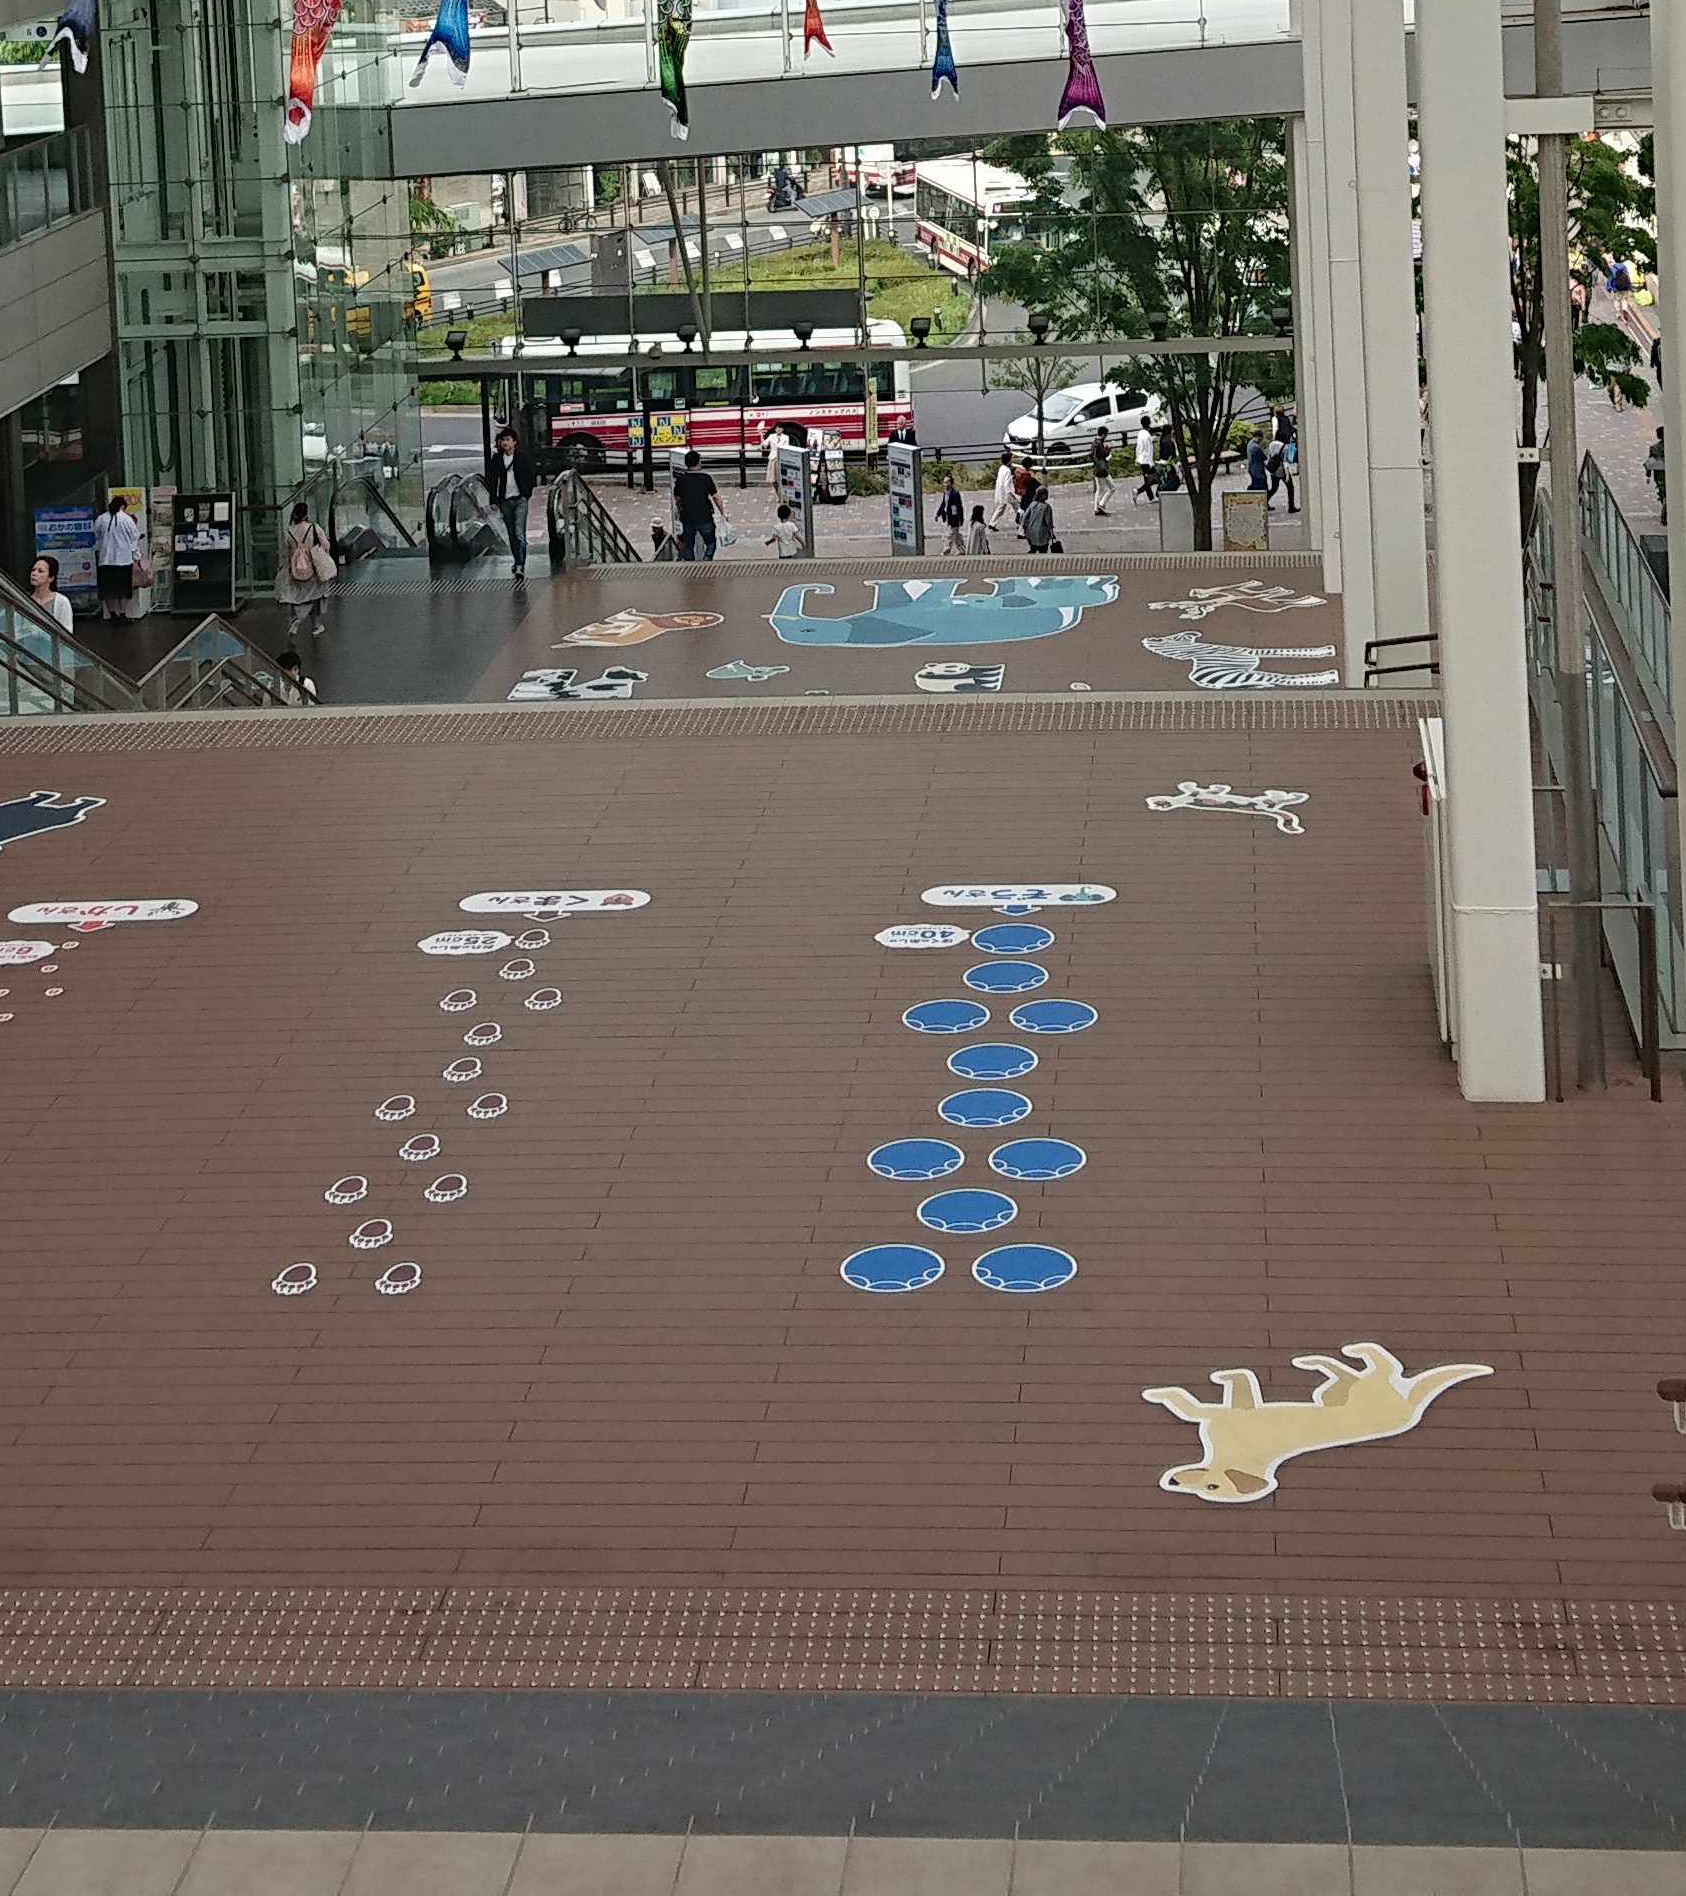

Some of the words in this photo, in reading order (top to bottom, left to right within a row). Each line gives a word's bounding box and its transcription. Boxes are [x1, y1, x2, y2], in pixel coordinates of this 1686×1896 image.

[488, 895, 589, 907] くまさん
[36, 905, 139, 917] しかさん
